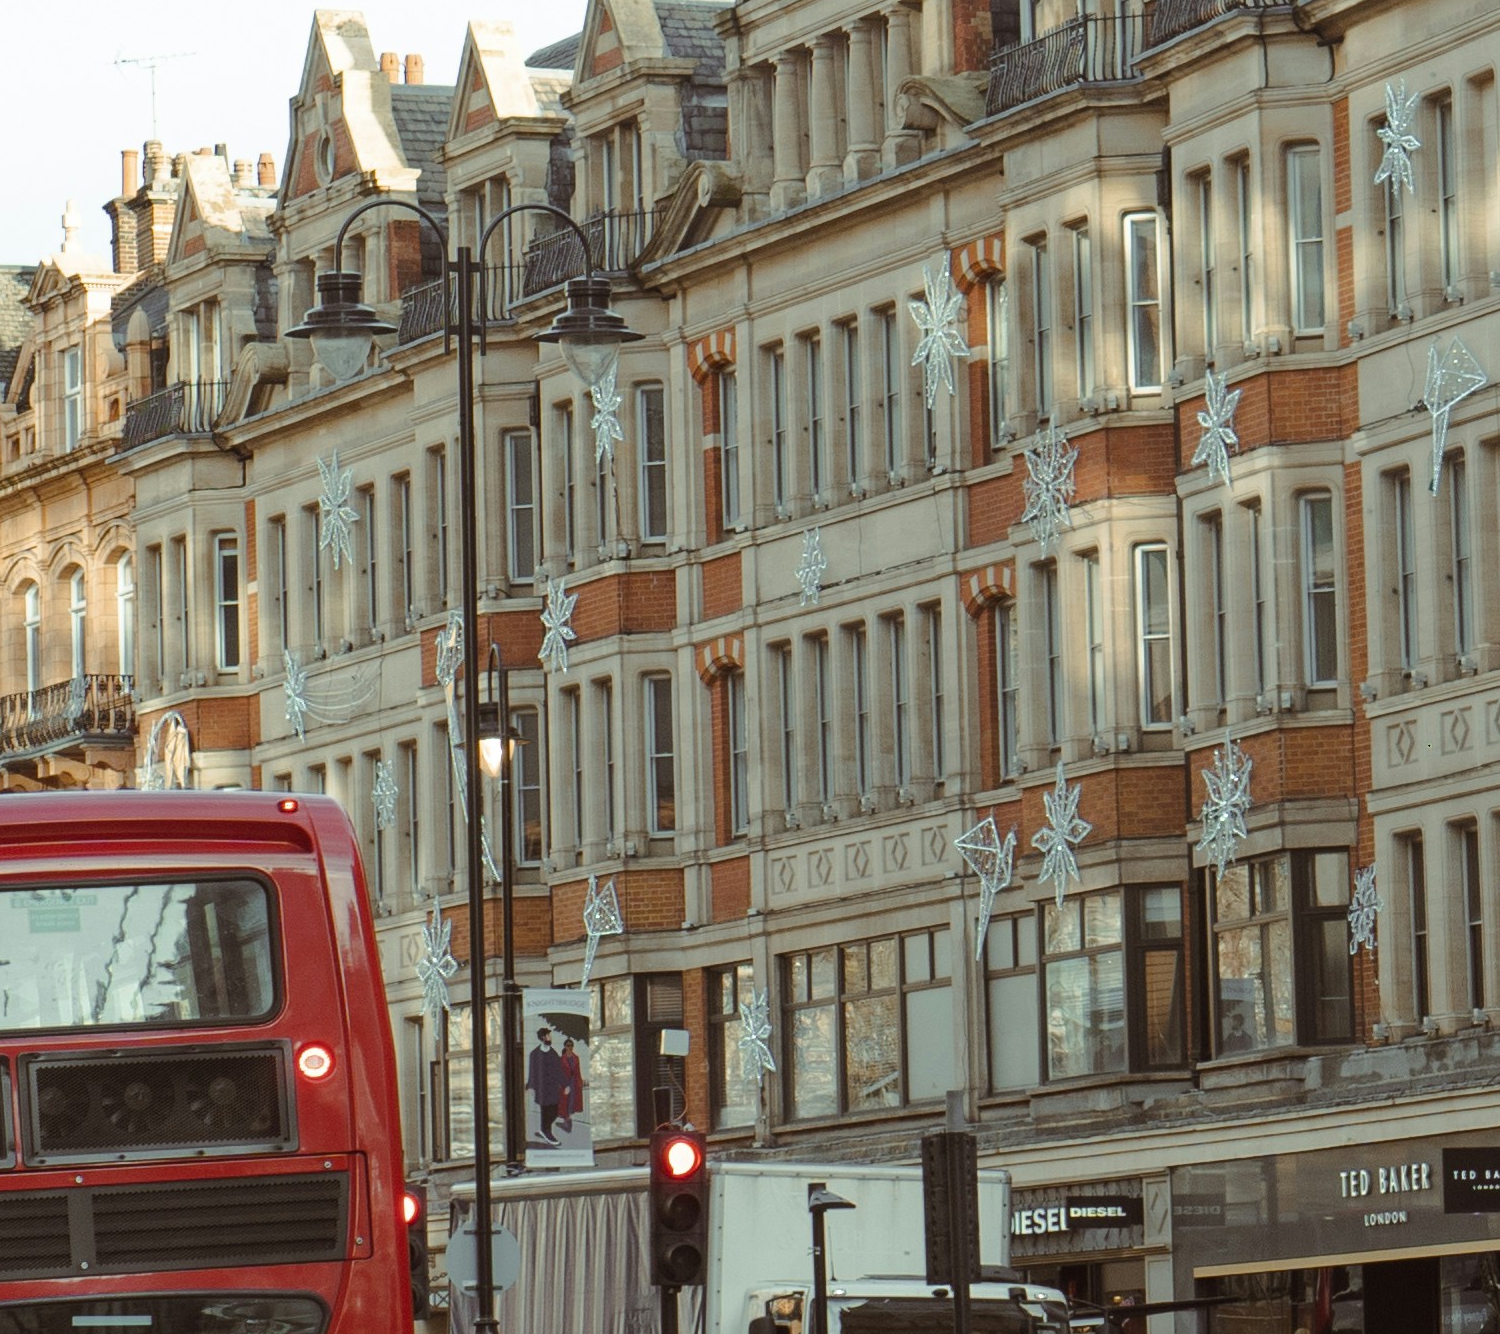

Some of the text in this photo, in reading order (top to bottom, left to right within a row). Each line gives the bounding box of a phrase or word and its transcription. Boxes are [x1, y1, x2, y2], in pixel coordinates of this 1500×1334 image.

[1340, 1163, 1431, 1198] TED BAKER
[1453, 1170, 1477, 1180] TED
[1070, 1206, 1126, 1218] DIESEL
[1364, 1210, 1408, 1227] LONDON
